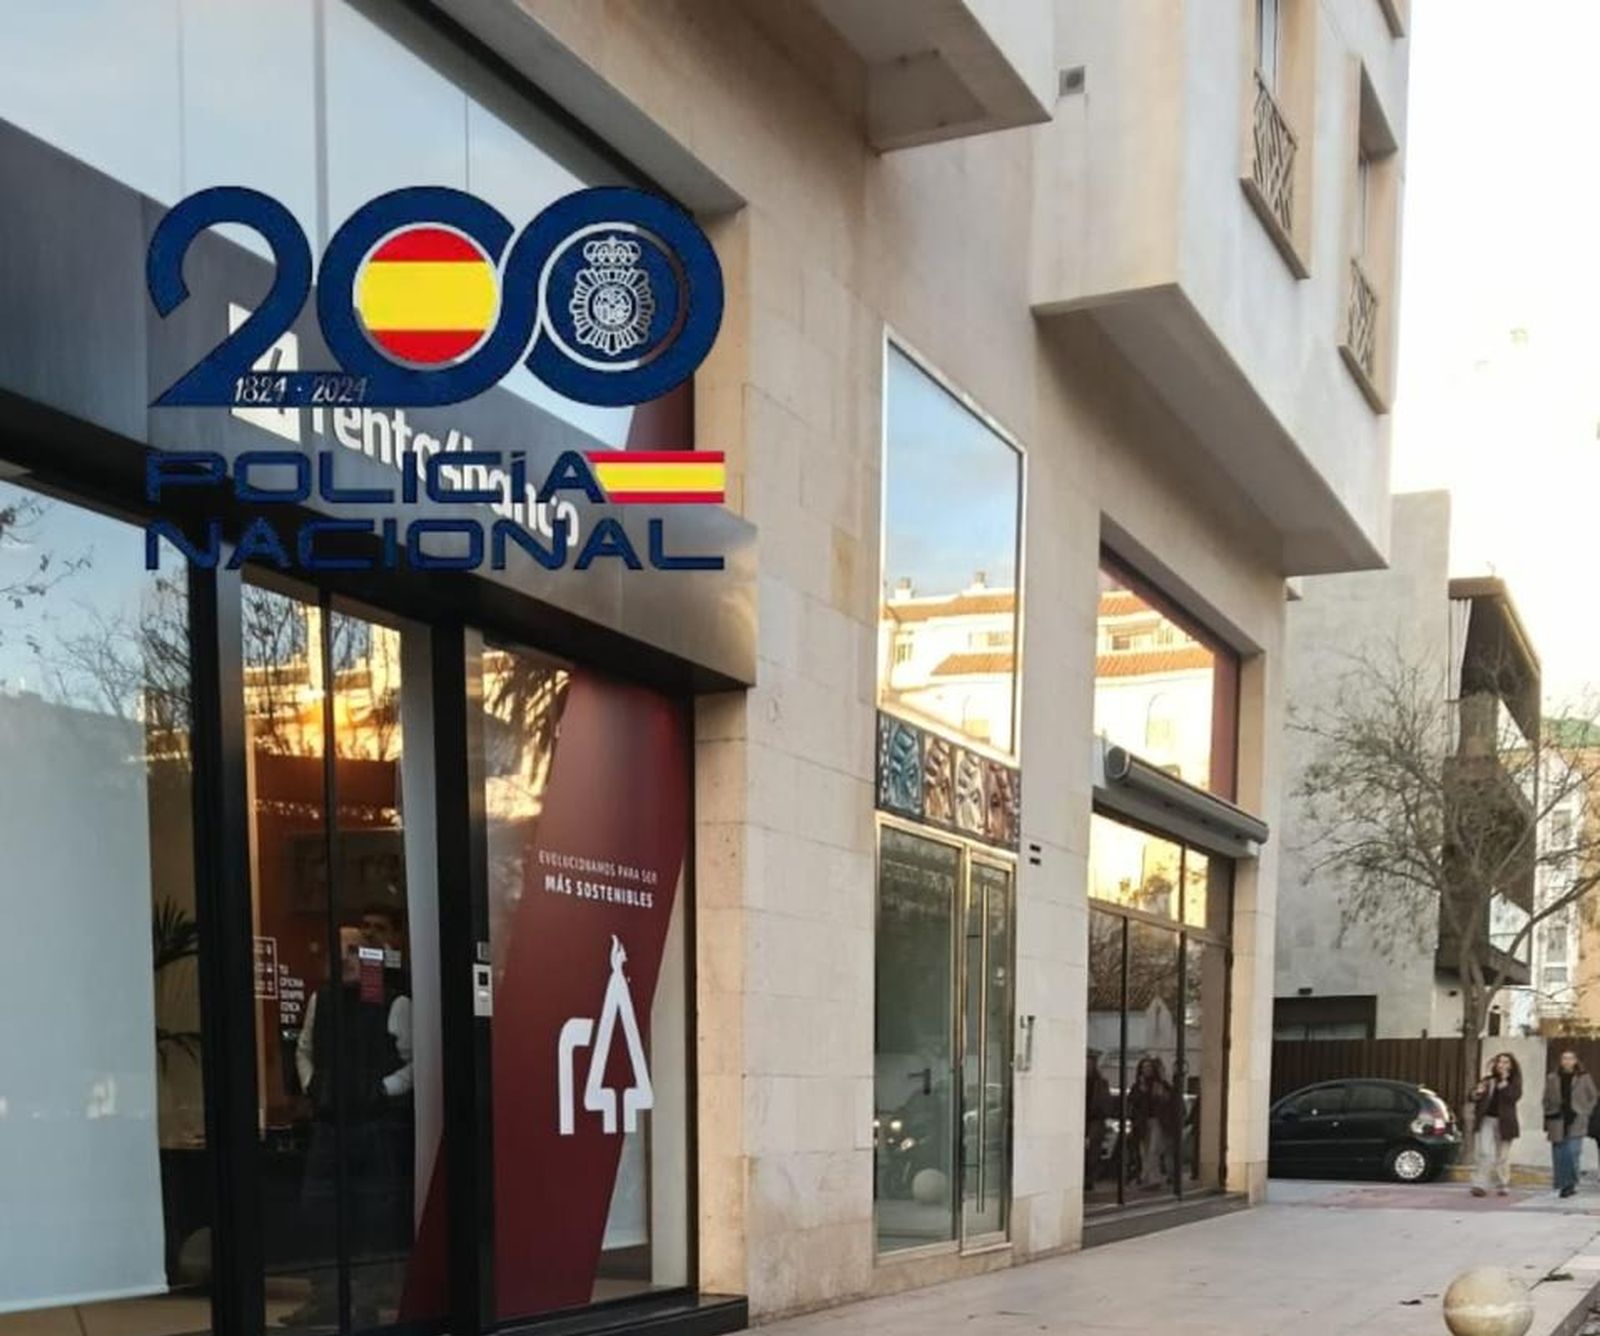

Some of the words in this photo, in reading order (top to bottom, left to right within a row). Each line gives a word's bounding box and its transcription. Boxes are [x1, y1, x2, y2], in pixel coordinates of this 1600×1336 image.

[538, 849, 616, 877] EVOLUCIONAMOS
[617, 865, 640, 880] PARA
[641, 869, 658, 885] SER
[544, 873, 572, 895] MÁS
[576, 880, 654, 909] SOSTENIBLES
